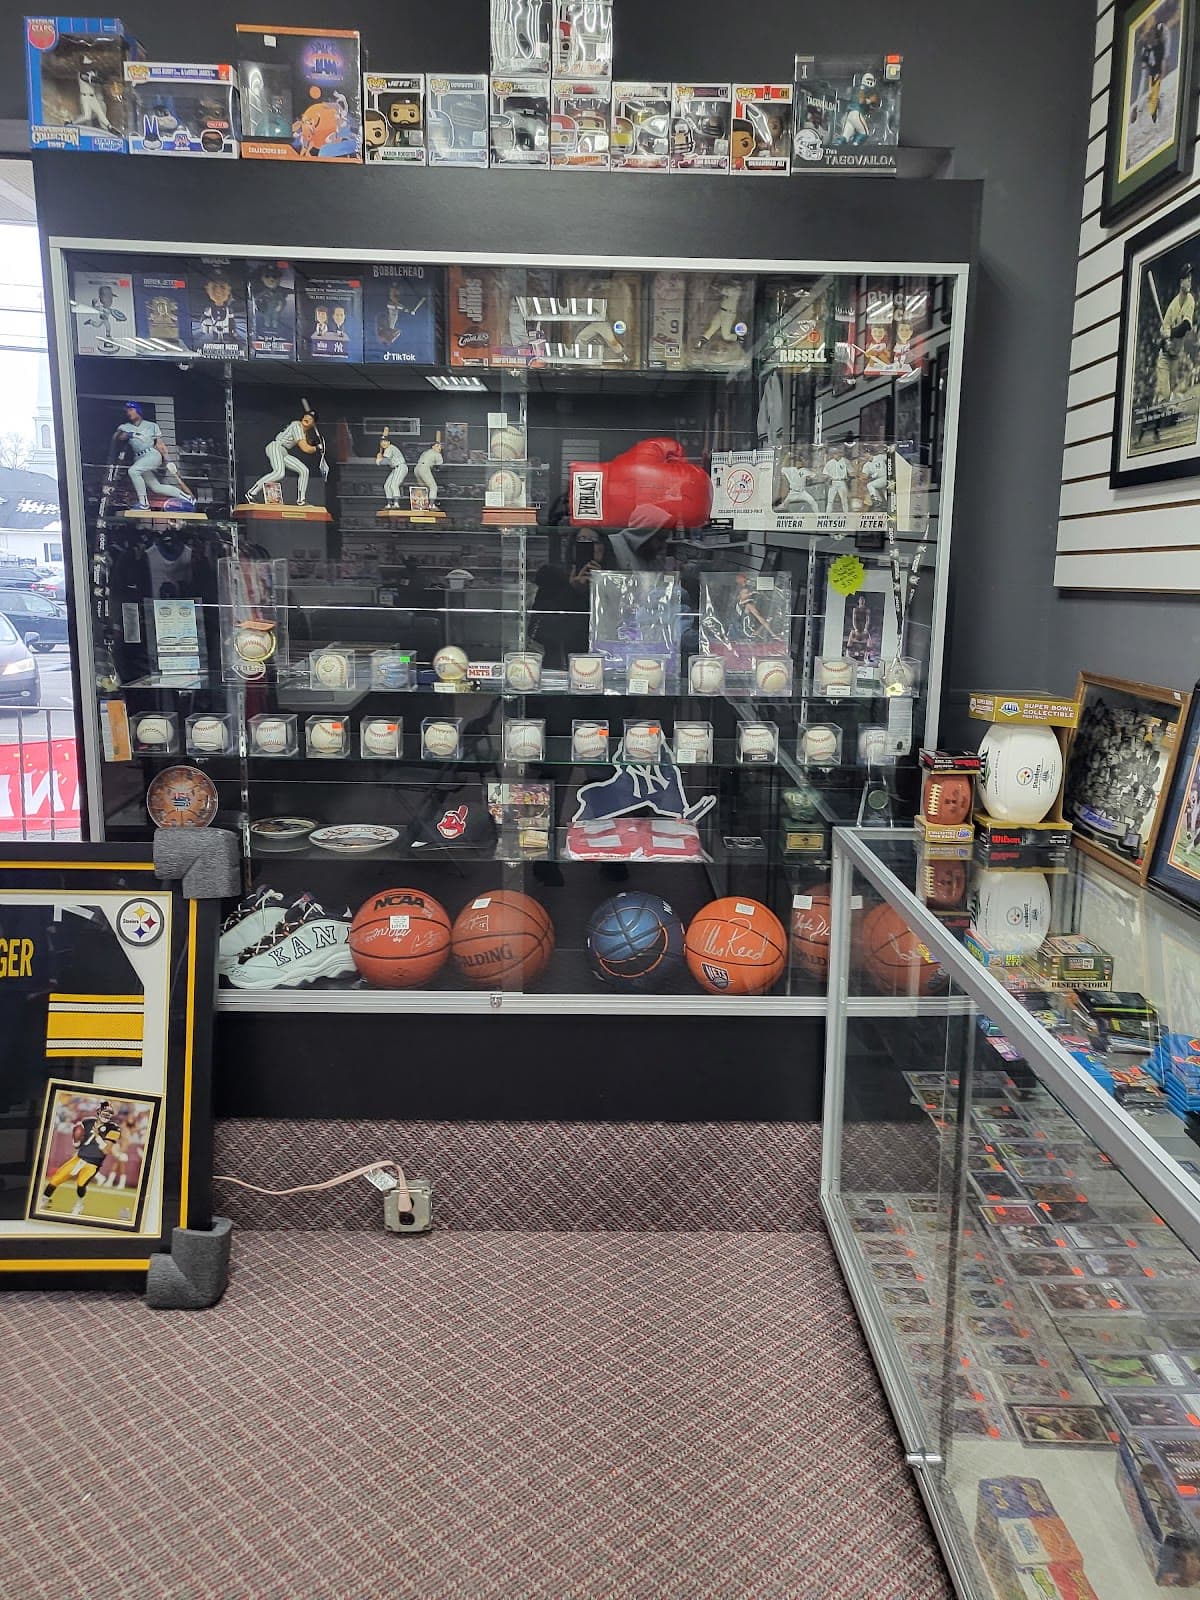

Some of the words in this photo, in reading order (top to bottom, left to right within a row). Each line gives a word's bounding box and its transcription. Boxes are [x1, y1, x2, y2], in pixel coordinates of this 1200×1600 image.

[824, 155, 896, 165] TAGOVAILOA
[373, 265, 424, 278] BOBBLEHEAD
[779, 349, 827, 362] RUSSELL
[577, 476, 599, 516] EVERLAST
[776, 520, 803, 528] RIVERA
[816, 520, 847, 528] MATSUI
[860, 520, 884, 528] JETER
[1023, 703, 1048, 711] SUPER
[1051, 704, 1073, 712] BOWL
[1023, 709, 1075, 719] COLLECTIBLE
[991, 835, 1021, 844] Wilson
[373, 895, 425, 911] NCAA
[461, 944, 513, 968] ALDING
[705, 964, 728, 980] NETS
[1051, 981, 1080, 989] DESERT
[1082, 981, 1109, 989] STORM
